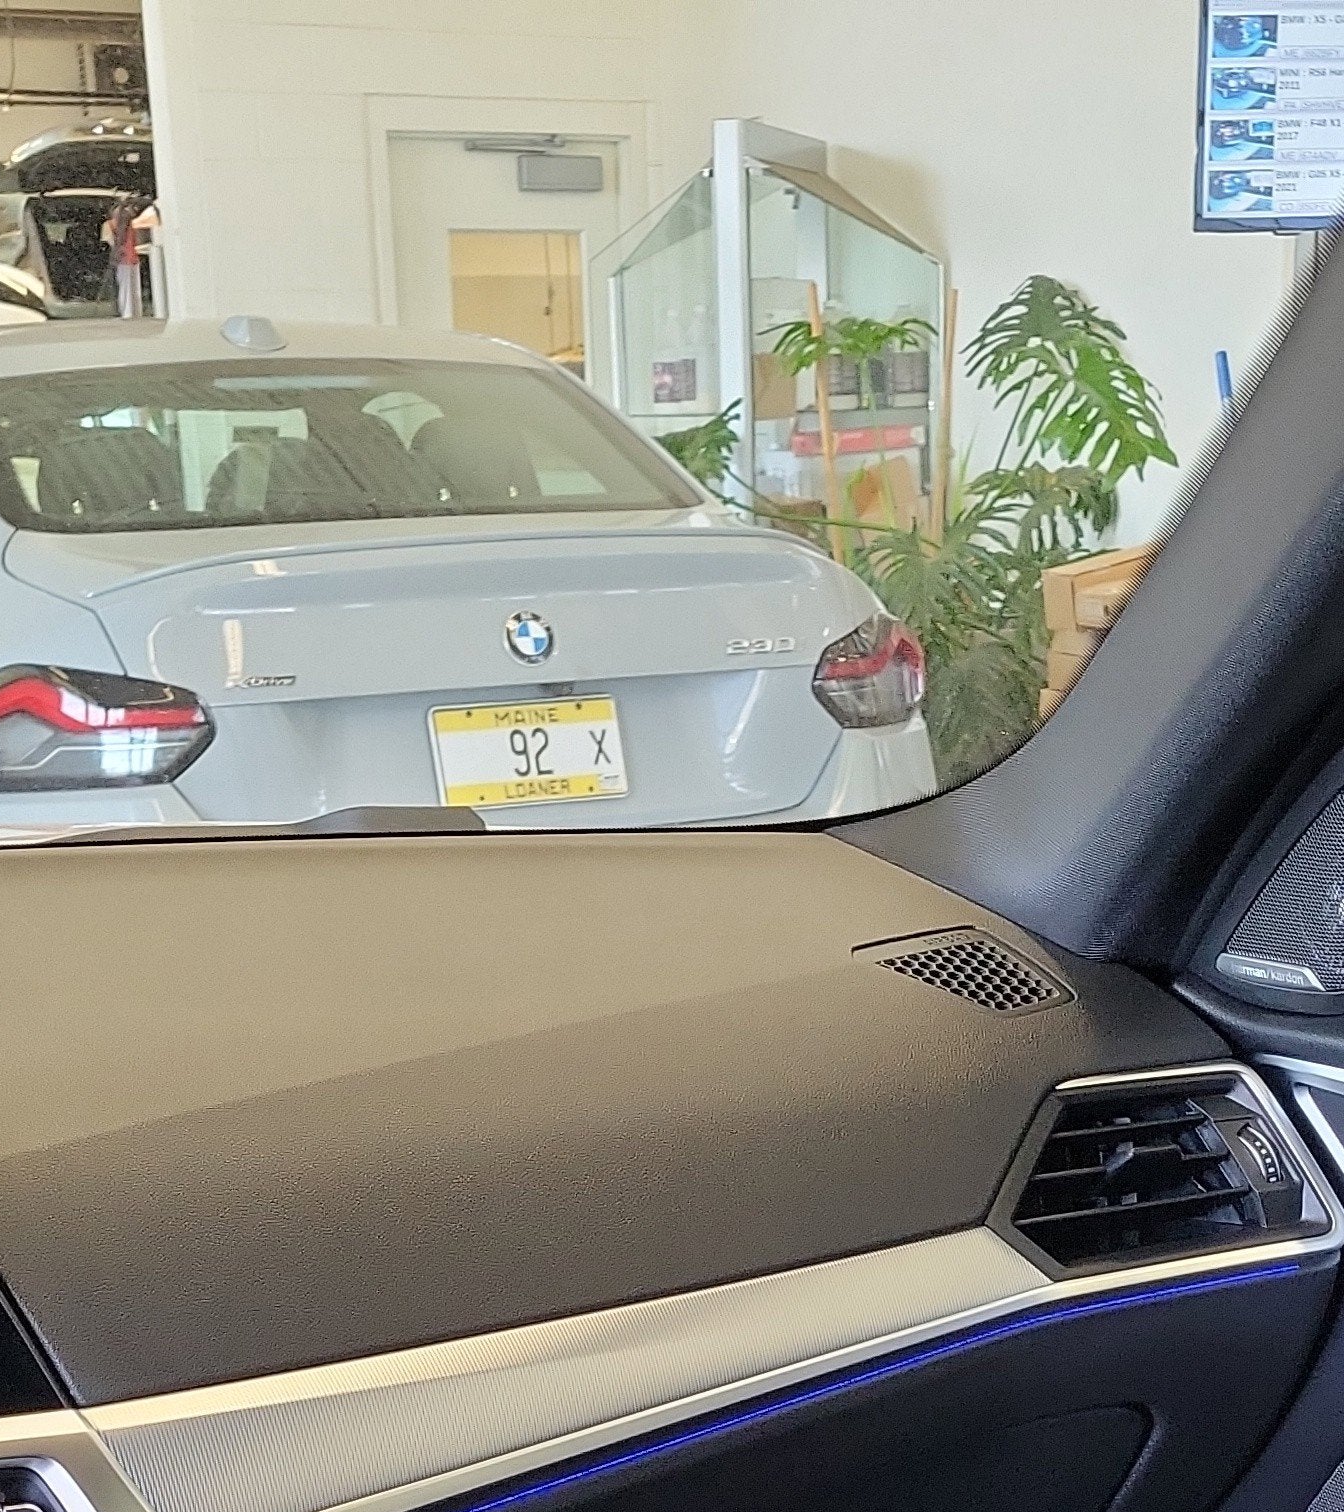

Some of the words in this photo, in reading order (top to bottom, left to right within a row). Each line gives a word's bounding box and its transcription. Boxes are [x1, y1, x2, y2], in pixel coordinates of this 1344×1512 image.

[495, 707, 559, 727] MAINE
[509, 727, 554, 777] 92
[588, 728, 612, 766] X
[505, 778, 571, 800] LOANER
